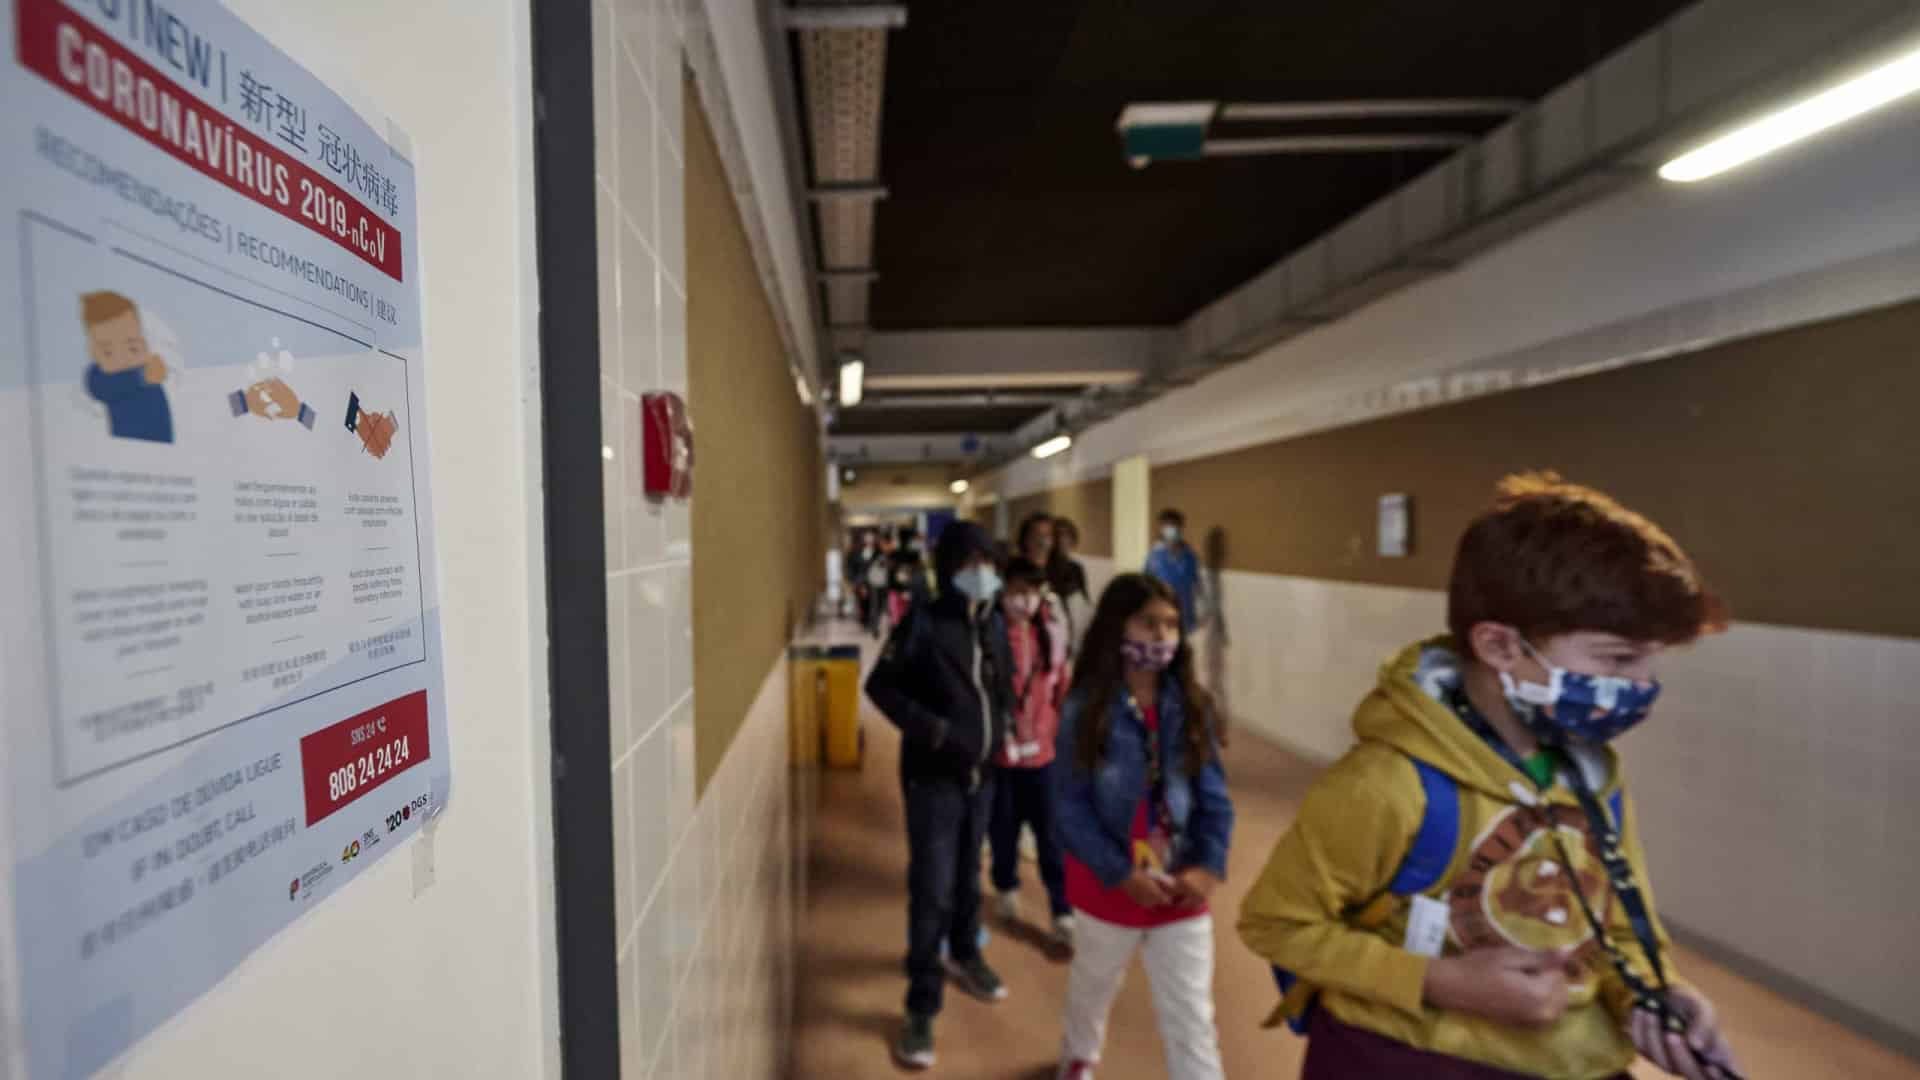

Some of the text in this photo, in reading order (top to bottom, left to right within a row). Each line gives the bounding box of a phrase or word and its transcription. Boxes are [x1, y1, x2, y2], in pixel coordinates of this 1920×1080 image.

[143, 0, 212, 88] NEW
[57, 22, 291, 207] CORONAVÍRUS
[240, 70, 399, 217] 新型 冠状病毒
[238, 232, 370, 310] RECOMMENDATIONS
[329, 735, 410, 801] 808 24 24 24
[411, 793, 428, 812] DGS
